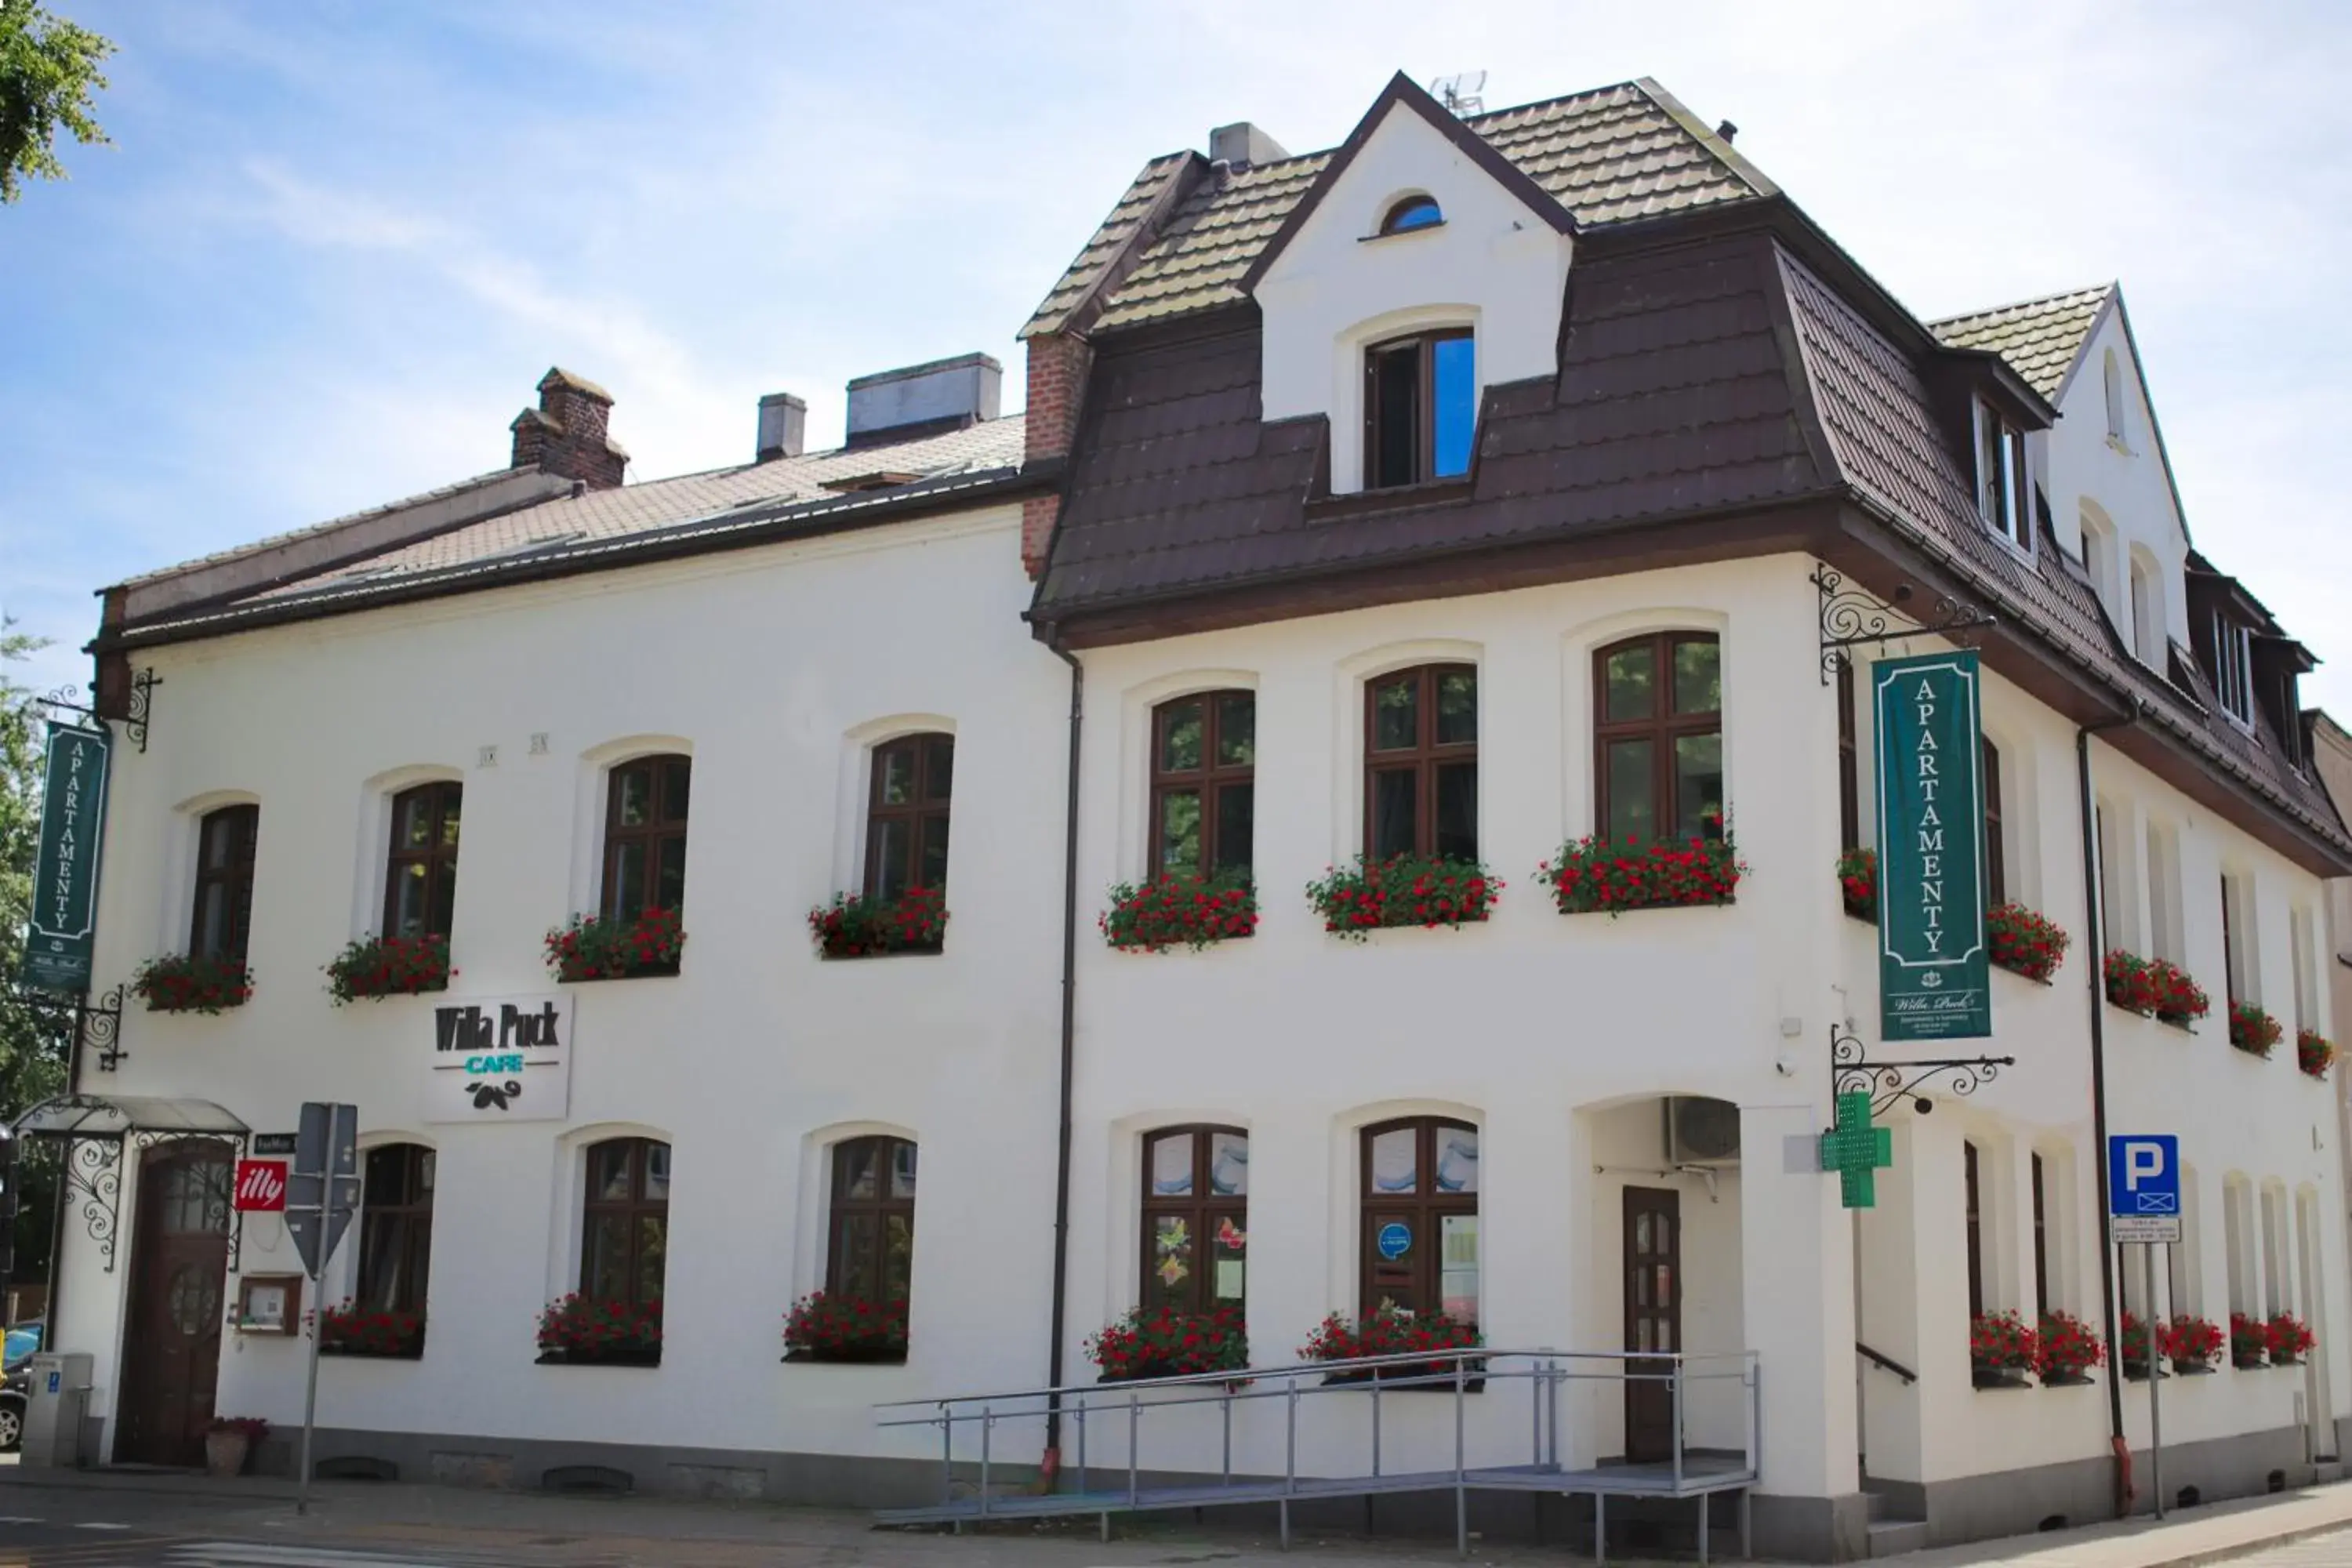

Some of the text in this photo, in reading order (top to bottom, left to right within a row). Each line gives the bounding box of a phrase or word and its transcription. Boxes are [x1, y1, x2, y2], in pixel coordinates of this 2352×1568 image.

[56, 741, 85, 930] APARTAMENTY
[1914, 678, 1943, 952] APARTAMENTY
[435, 1001, 559, 1051] Willa Puck
[465, 1054, 523, 1074] CAFE
[241, 1167, 282, 1207] illy
[2125, 1142, 2164, 1191] P
